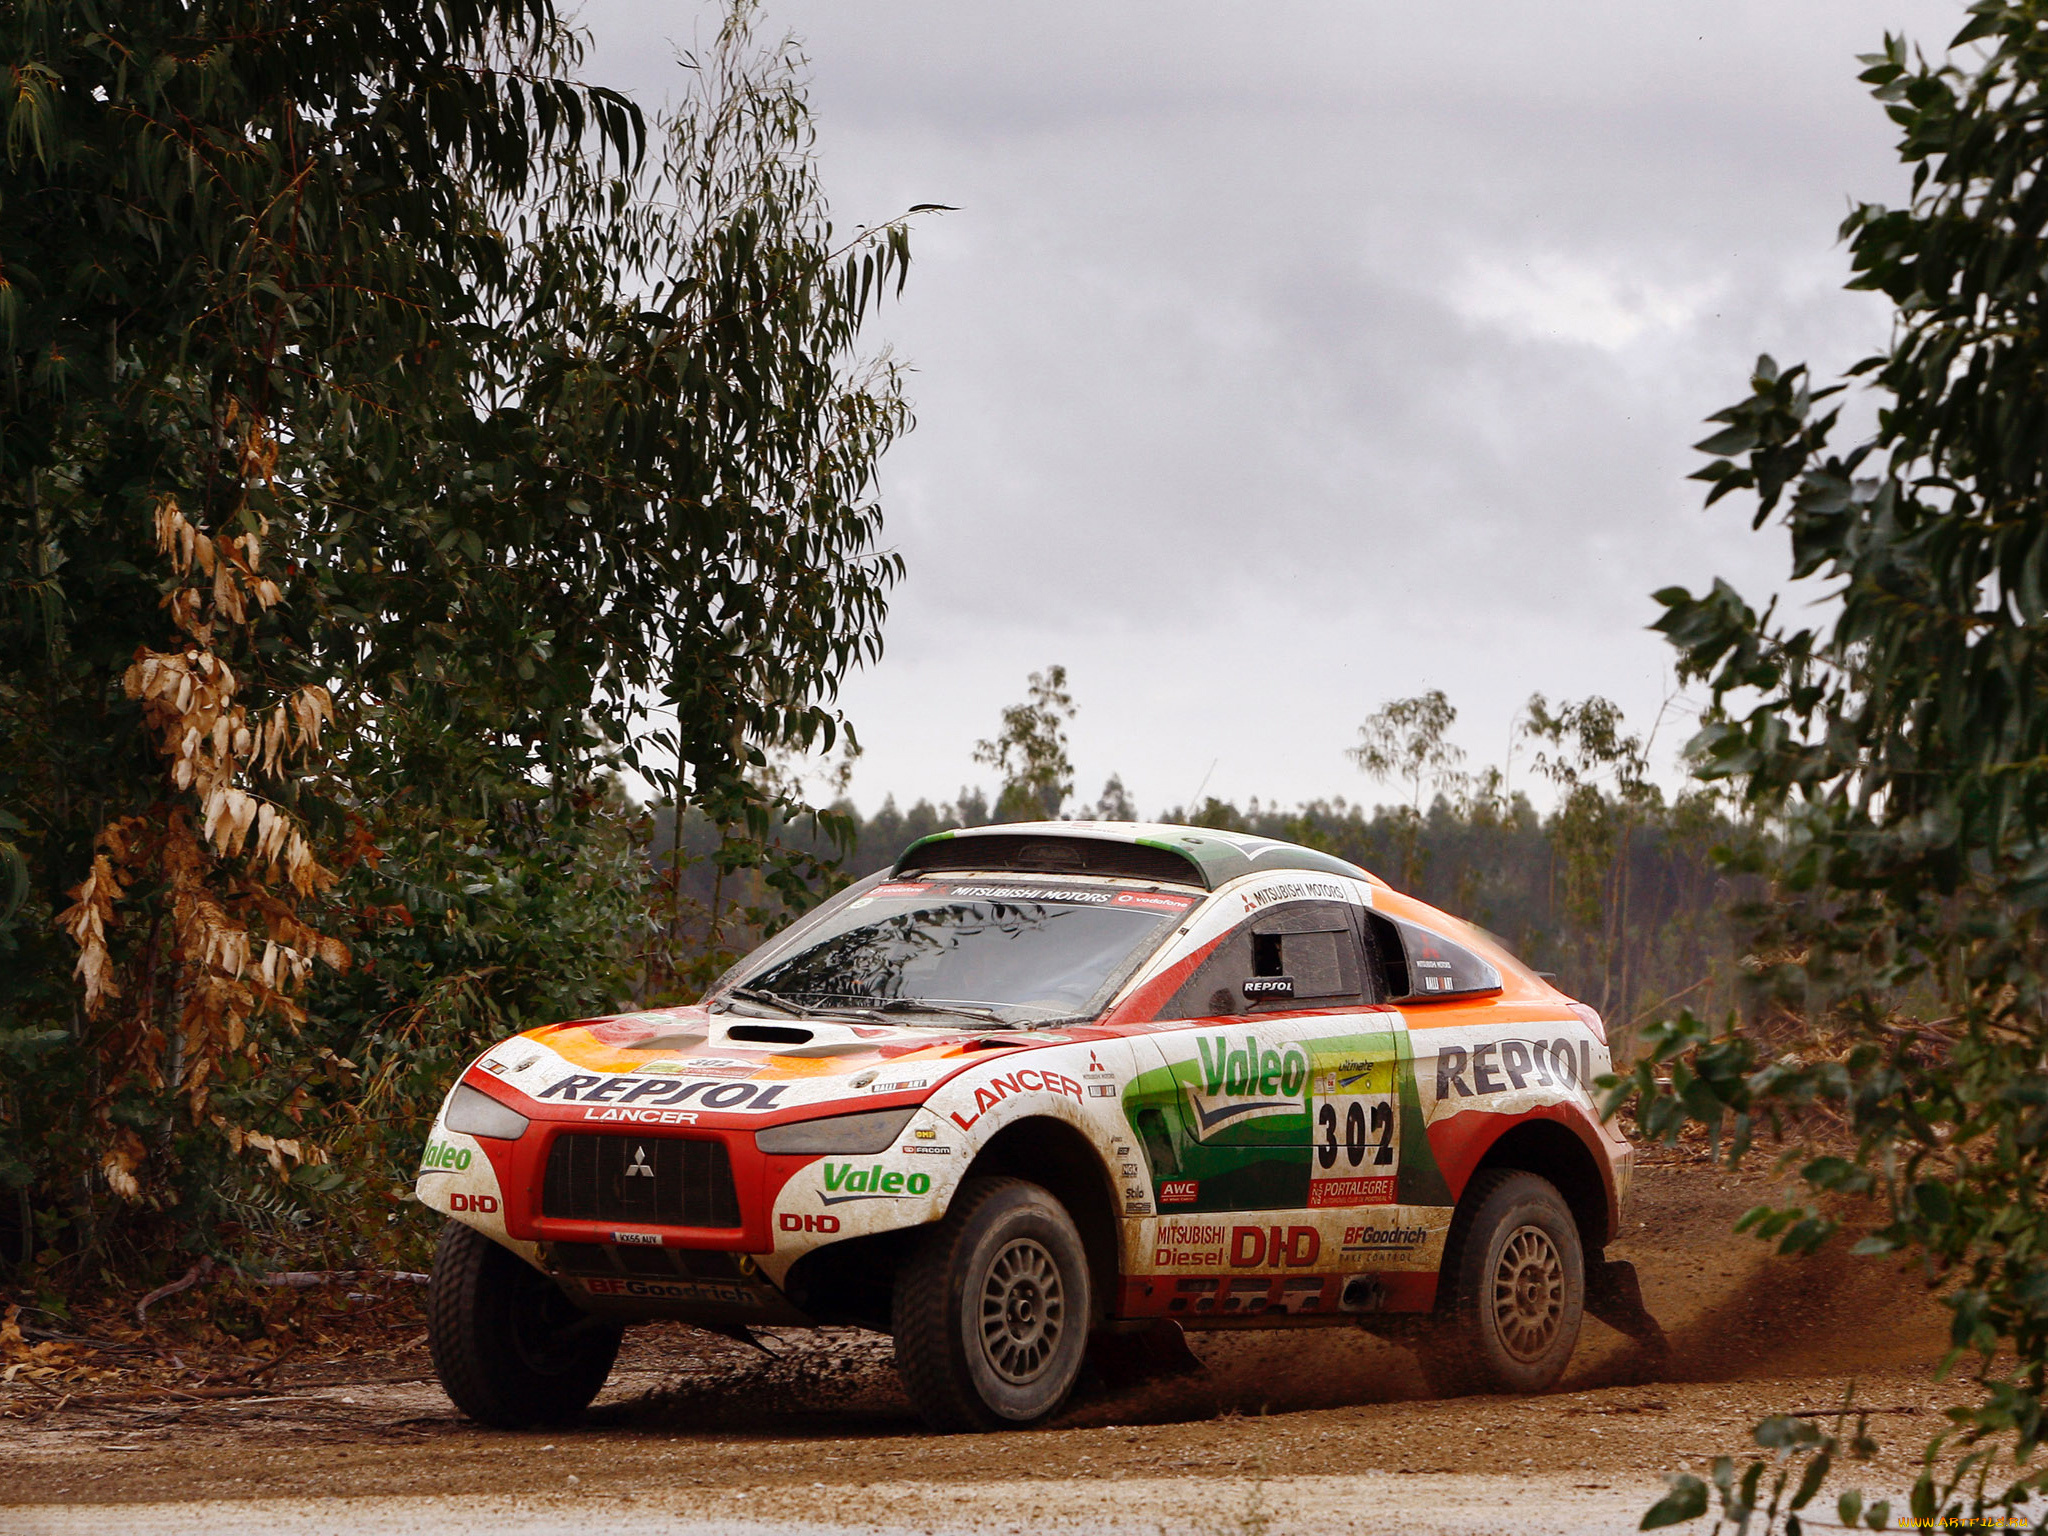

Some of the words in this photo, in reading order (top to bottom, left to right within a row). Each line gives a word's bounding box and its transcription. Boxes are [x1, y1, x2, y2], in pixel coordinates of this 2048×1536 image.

[951, 887, 1040, 899] MITSUBISHI
[1043, 890, 1112, 903] MOTORS
[1136, 897, 1188, 908] vodafone
[1253, 883, 1304, 906] MITSUBISHI
[1305, 884, 1344, 899] MOTORS
[1244, 982, 1292, 991] REPSOL
[1196, 1036, 1304, 1097] Valeo
[1338, 1059, 1374, 1071] ultimate
[1436, 1038, 1598, 1100] REPSOL
[538, 1074, 791, 1109] REPSOL
[950, 1069, 1084, 1132] LANCER
[584, 1107, 699, 1125] LANCER
[1318, 1101, 1394, 1169] 302
[824, 1163, 931, 1194] Valeo
[1324, 1180, 1388, 1196] PORTALEGRE
[1164, 1183, 1195, 1194] AWC
[1158, 1226, 1225, 1245] MITSUBISHI
[1343, 1226, 1427, 1245] BFGoodrich
[1155, 1248, 1223, 1266] Diesel
[588, 1279, 754, 1301] BFGoodrich
